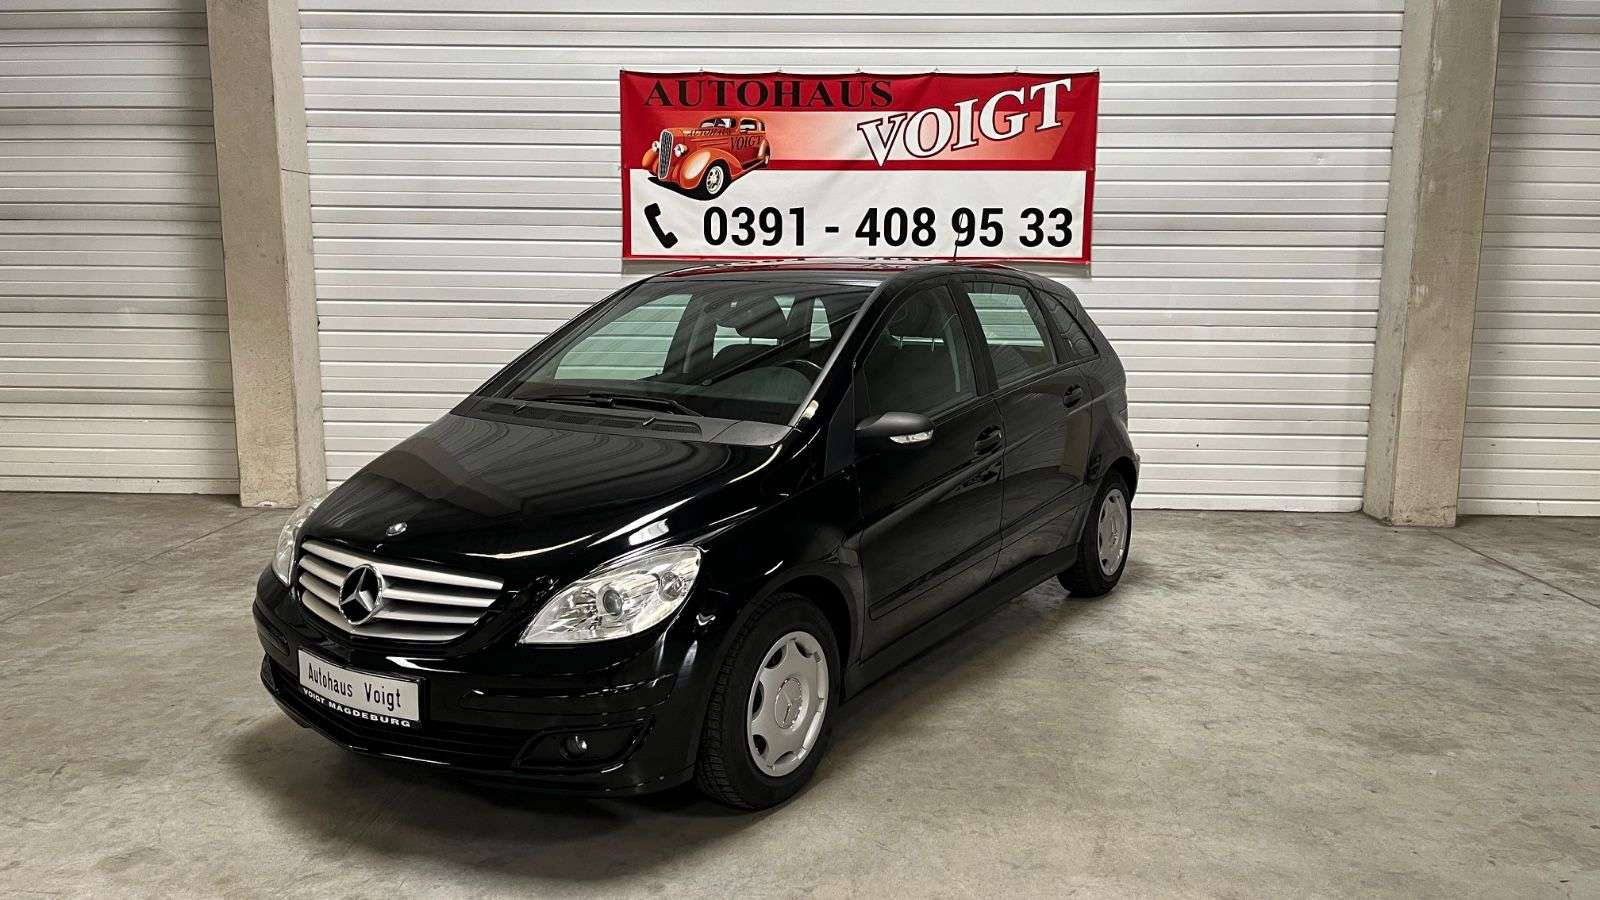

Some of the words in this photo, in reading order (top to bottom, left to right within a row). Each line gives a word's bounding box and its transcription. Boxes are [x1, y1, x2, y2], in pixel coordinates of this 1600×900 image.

[643, 79, 893, 108] AUTOHAUS
[730, 135, 764, 150] VOIGT
[857, 78, 1073, 167] VOIGT
[703, 206, 804, 247] 0391
[855, 207, 936, 247] 408
[952, 207, 1003, 248] 95
[1019, 207, 1073, 248] 33
[303, 687, 325, 704] VOIGT
[328, 701, 411, 727] MAGDEBURG
[308, 663, 353, 697] Autohaus
[364, 682, 401, 712] Voigt
